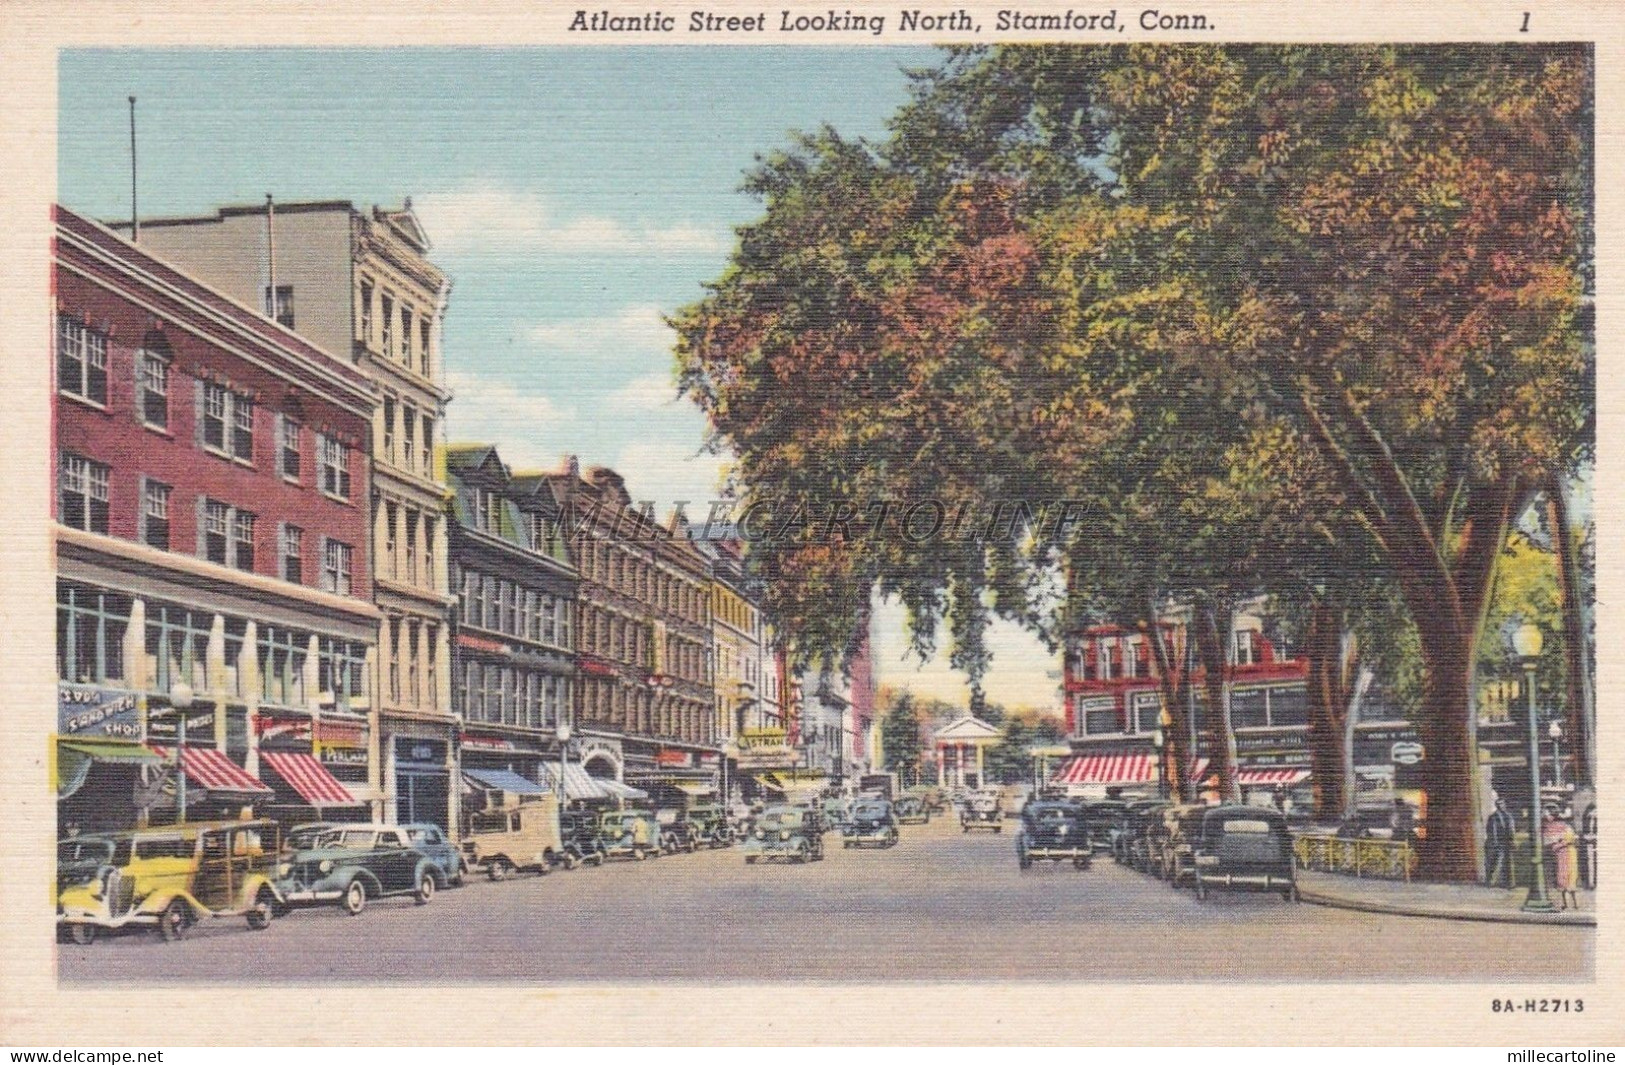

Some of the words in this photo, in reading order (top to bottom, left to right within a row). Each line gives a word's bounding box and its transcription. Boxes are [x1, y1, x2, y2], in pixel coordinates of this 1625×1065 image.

[568, 10, 675, 32] Atlantic
[689, 10, 766, 32] Street
[779, 10, 885, 36] Looking
[899, 9, 981, 36] North,
[996, 10, 1125, 36] Stamford,
[1139, 9, 1215, 31] Conn.
[1519, 12, 1530, 32] 1
[1492, 999, 1584, 1013] 8A-H2713
